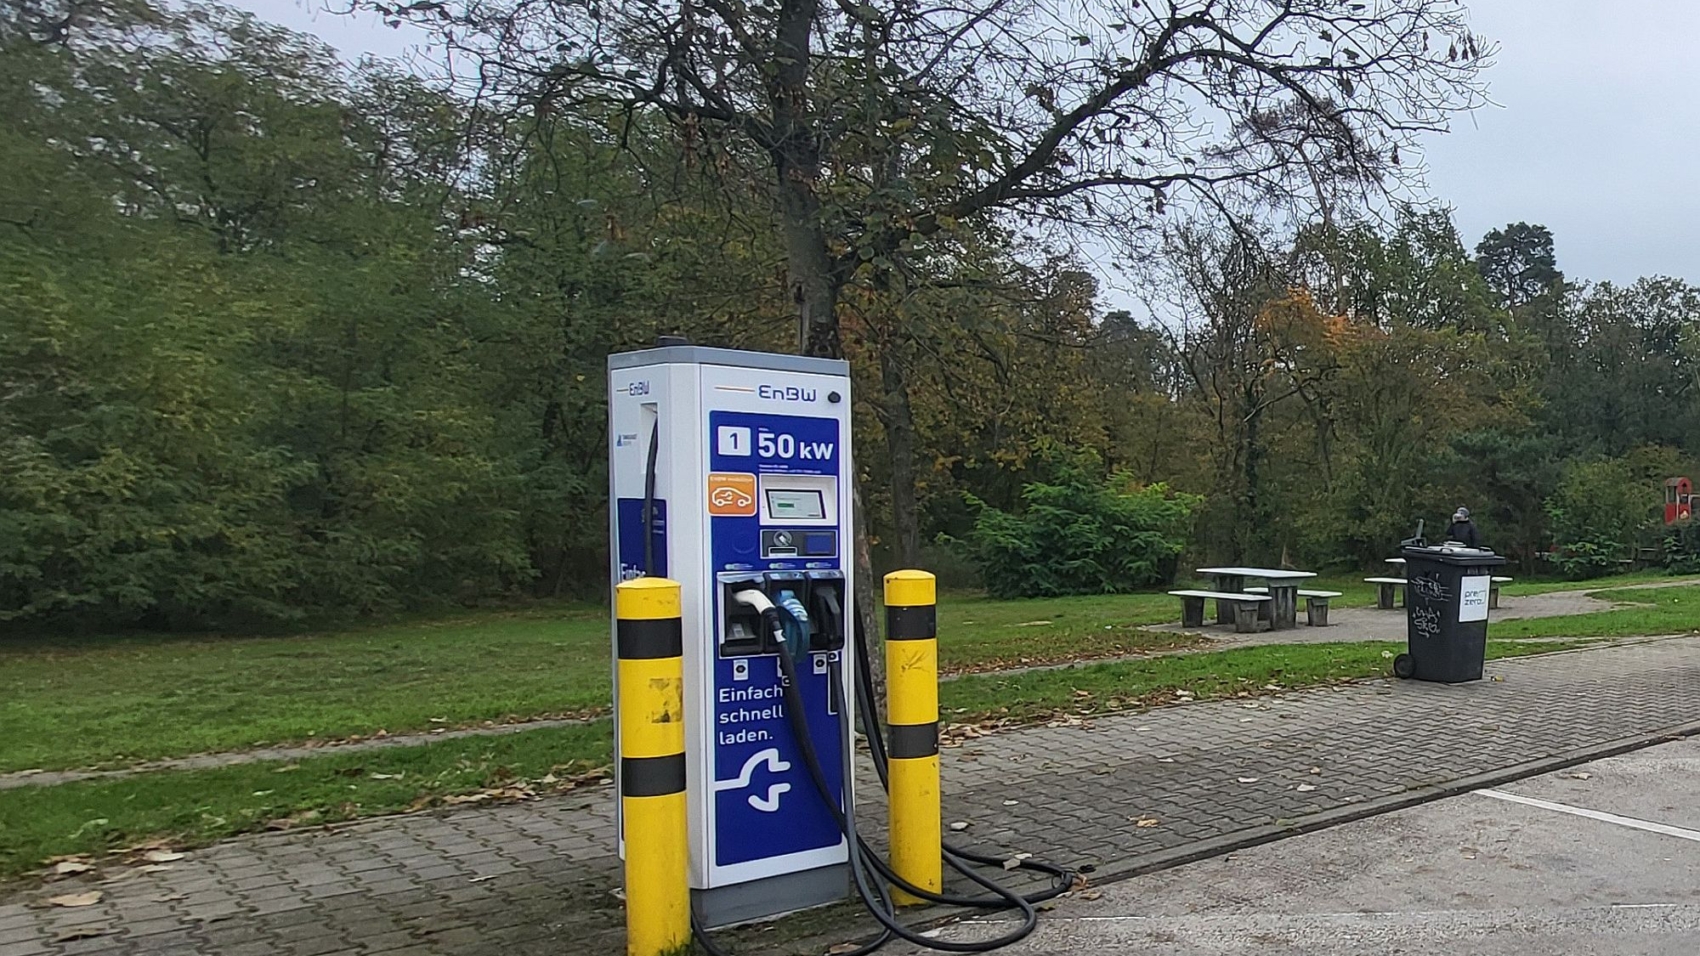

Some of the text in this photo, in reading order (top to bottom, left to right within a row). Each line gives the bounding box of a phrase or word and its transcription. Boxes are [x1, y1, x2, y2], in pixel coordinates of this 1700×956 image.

[629, 381, 649, 396] EnBW
[758, 384, 817, 402] EnBW
[729, 432, 833, 460] 1 50 kW
[719, 684, 783, 702] Einfach
[719, 705, 783, 724] schnell
[719, 729, 773, 745] laden.
